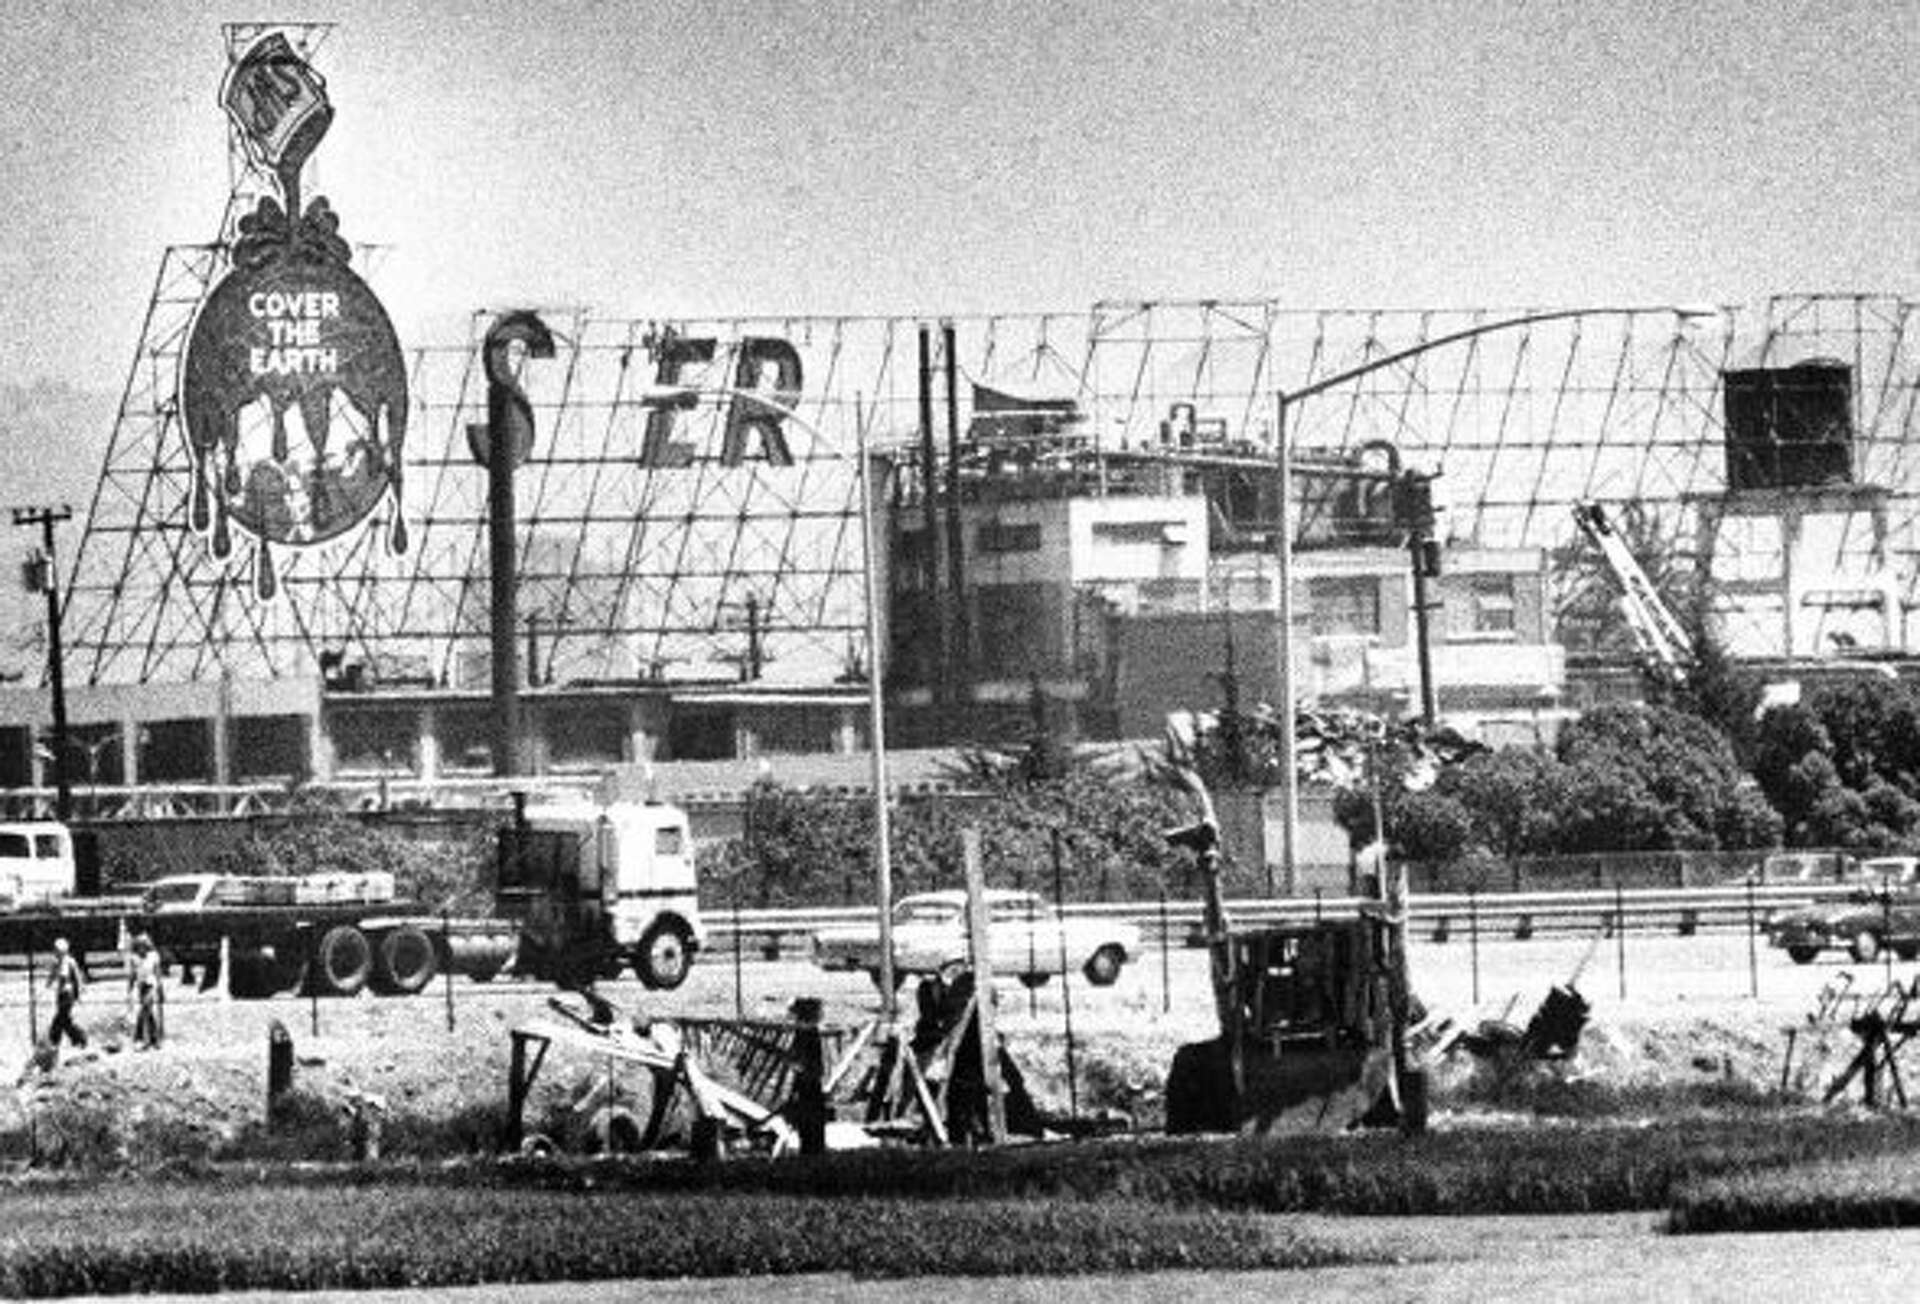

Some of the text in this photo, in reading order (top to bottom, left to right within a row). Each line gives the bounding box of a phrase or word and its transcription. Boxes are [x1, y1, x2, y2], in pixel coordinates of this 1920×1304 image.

[249, 291, 340, 319] COVER
[267, 319, 321, 346] THE
[250, 346, 338, 375] EARTH
[637, 336, 803, 469] ER
